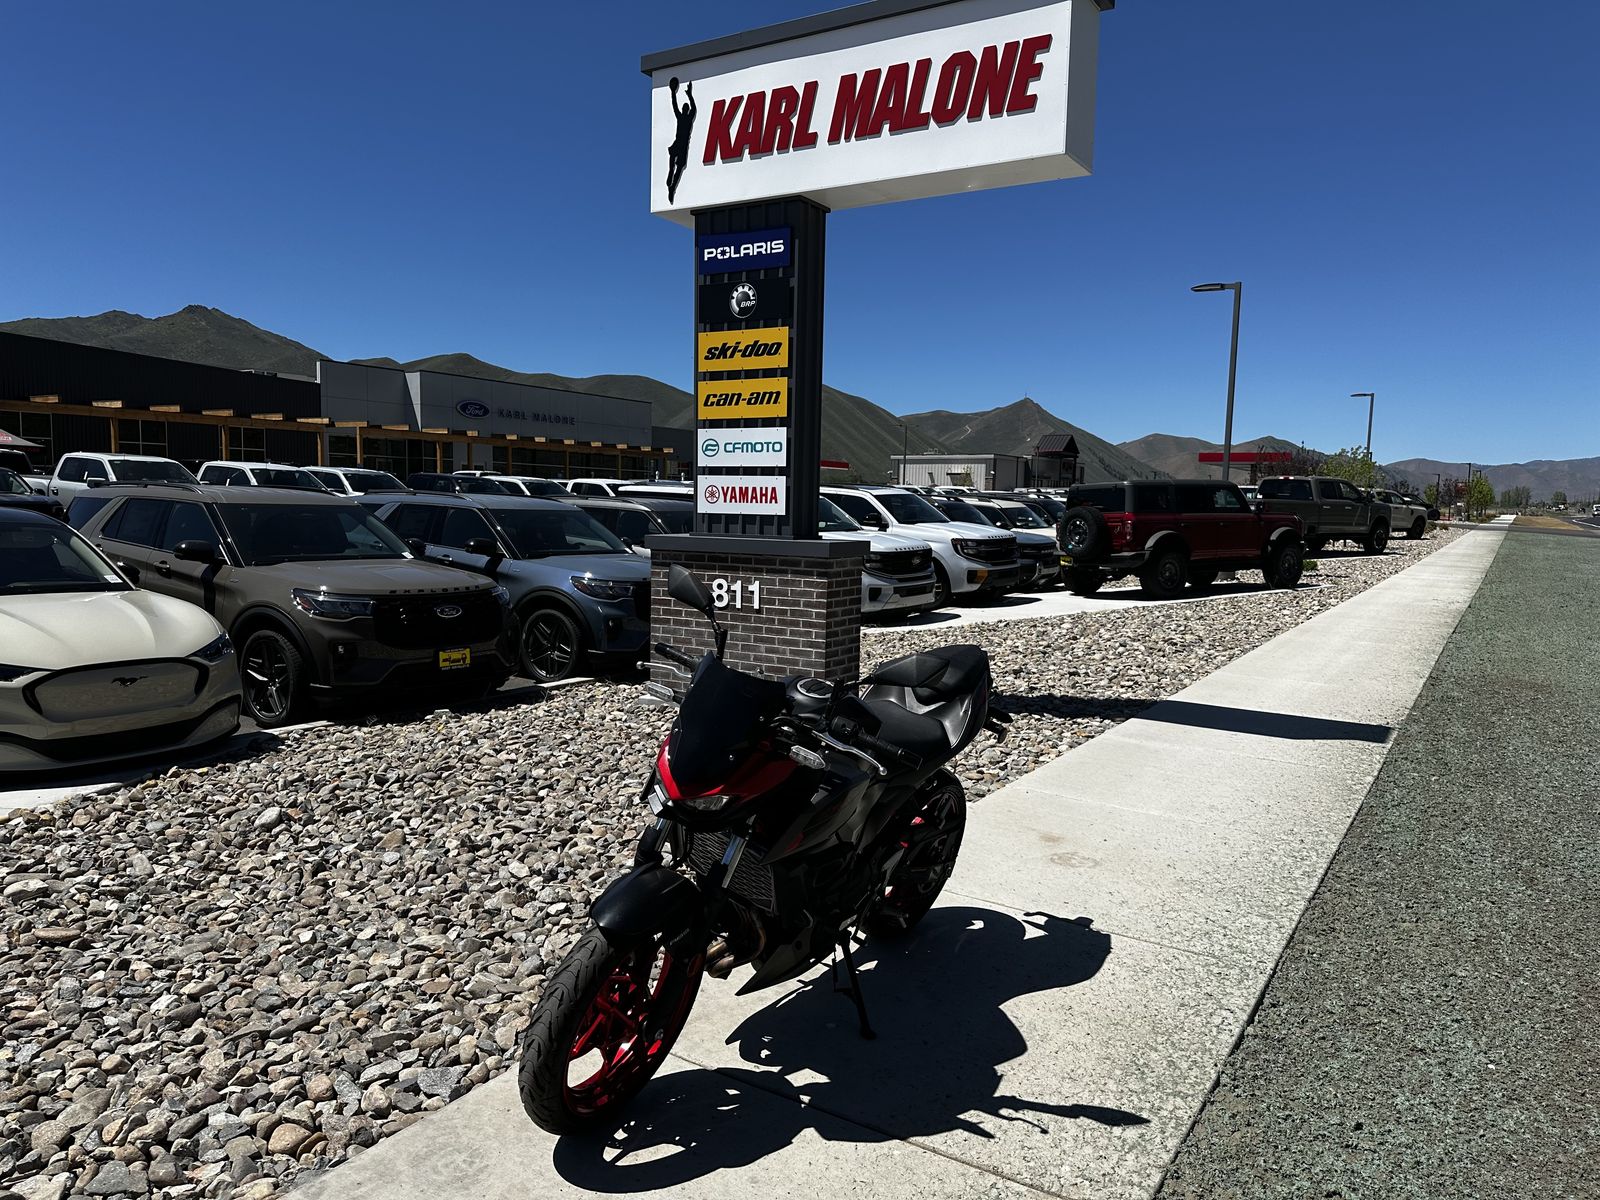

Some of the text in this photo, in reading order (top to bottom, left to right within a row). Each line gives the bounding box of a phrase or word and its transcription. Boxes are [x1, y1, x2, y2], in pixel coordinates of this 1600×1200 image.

[703, 34, 1053, 165] KARL MALONE
[704, 240, 785, 261] POLARIS
[740, 300, 756, 308] BRP
[703, 340, 783, 361] ski-doo
[703, 390, 781, 407] can-am
[498, 408, 576, 426] KARL MALONE
[723, 441, 783, 454] CFMOTO
[721, 486, 779, 504] YAMAHA
[711, 578, 760, 610] 811
